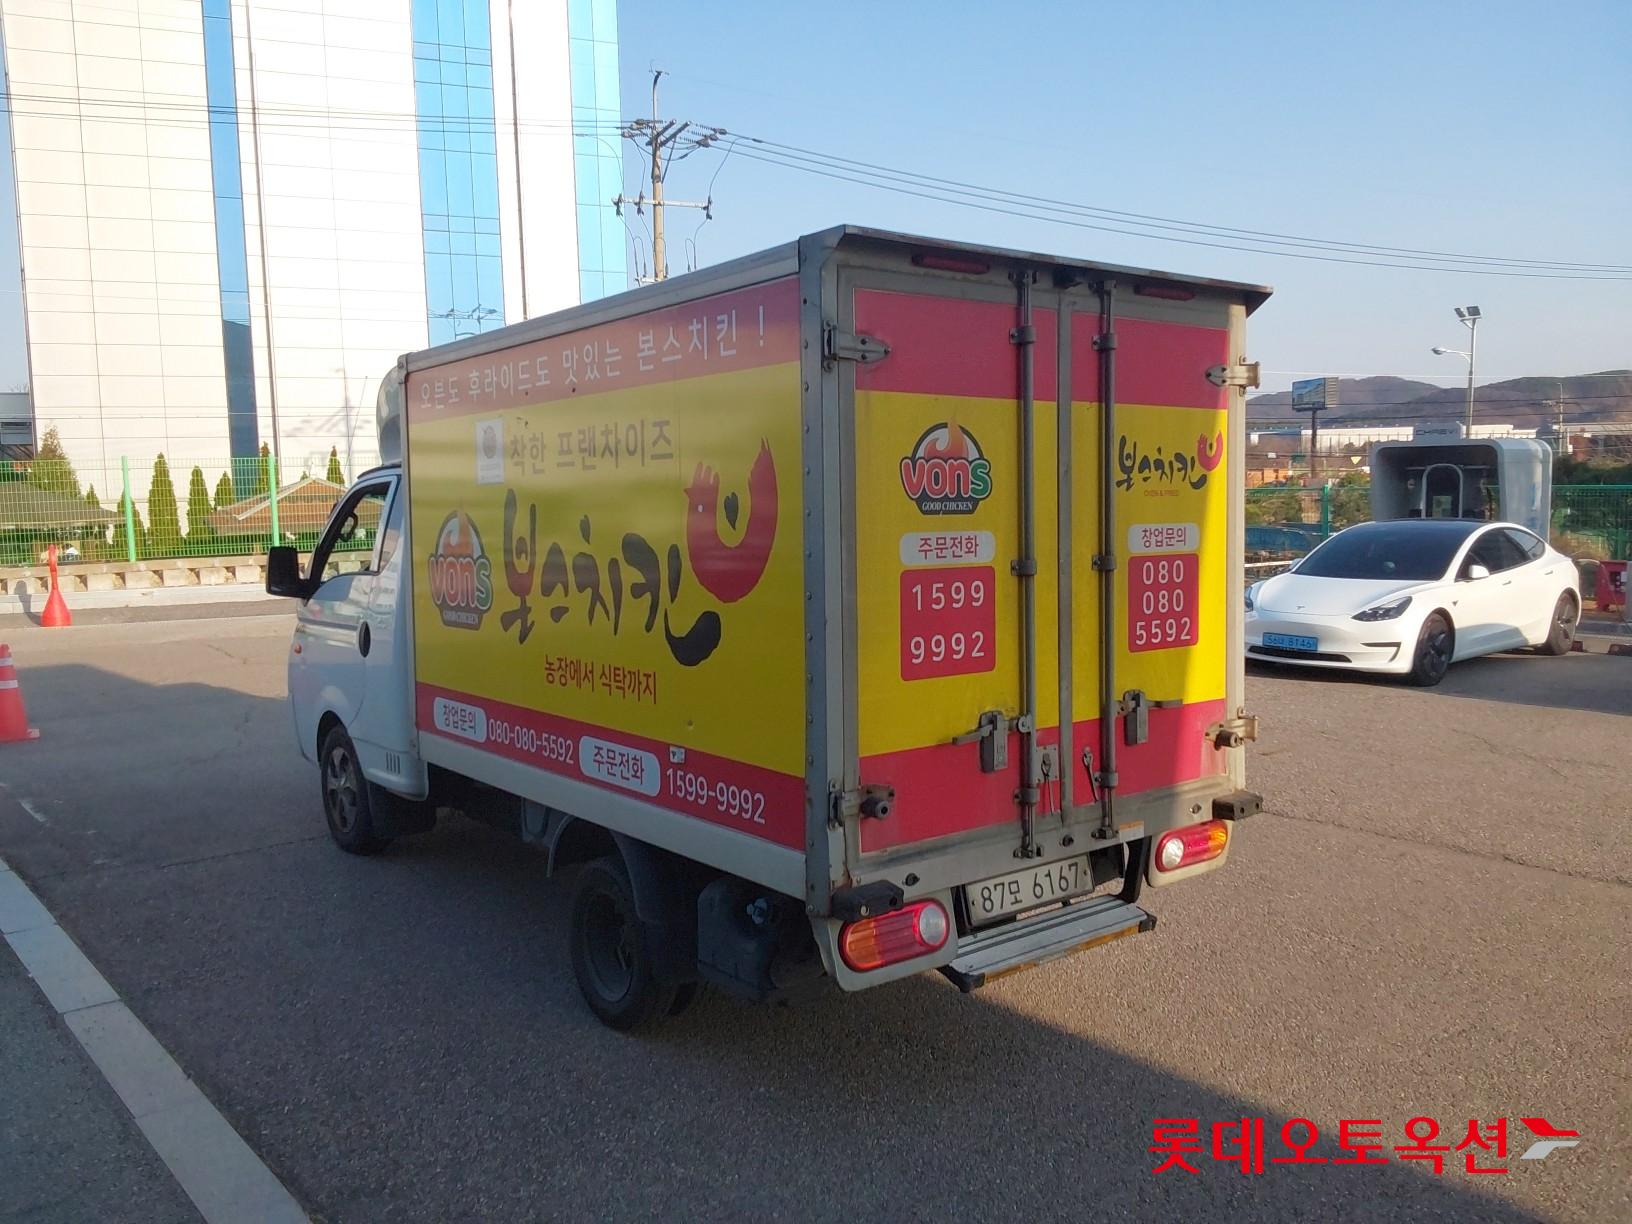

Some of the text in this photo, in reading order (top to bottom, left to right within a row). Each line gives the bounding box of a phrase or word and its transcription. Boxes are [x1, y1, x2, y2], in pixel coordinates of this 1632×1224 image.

[420, 376, 459, 409] 오븐도
[468, 356, 551, 402] 후라이드도
[562, 339, 622, 385] 맛있는
[637, 309, 737, 371] 본스치킨
[509, 419, 674, 477] 착한 프랜차이즈
[901, 457, 991, 500] vons
[918, 535, 979, 560] 주문전화
[1141, 526, 1187, 548] 창업문의
[428, 554, 493, 612] vons
[1142, 559, 1184, 585] 080
[911, 580, 985, 611] 1599
[1142, 589, 1184, 615] 080
[910, 631, 985, 664] 9992
[1135, 616, 1192, 646] 5592
[544, 654, 656, 705] 농장에서 식탁까지
[443, 703, 574, 764] 창업문의 080-080-5592
[592, 745, 766, 825] 주문전화 1599-9992
[981, 862, 1079, 913] 87모 6167
